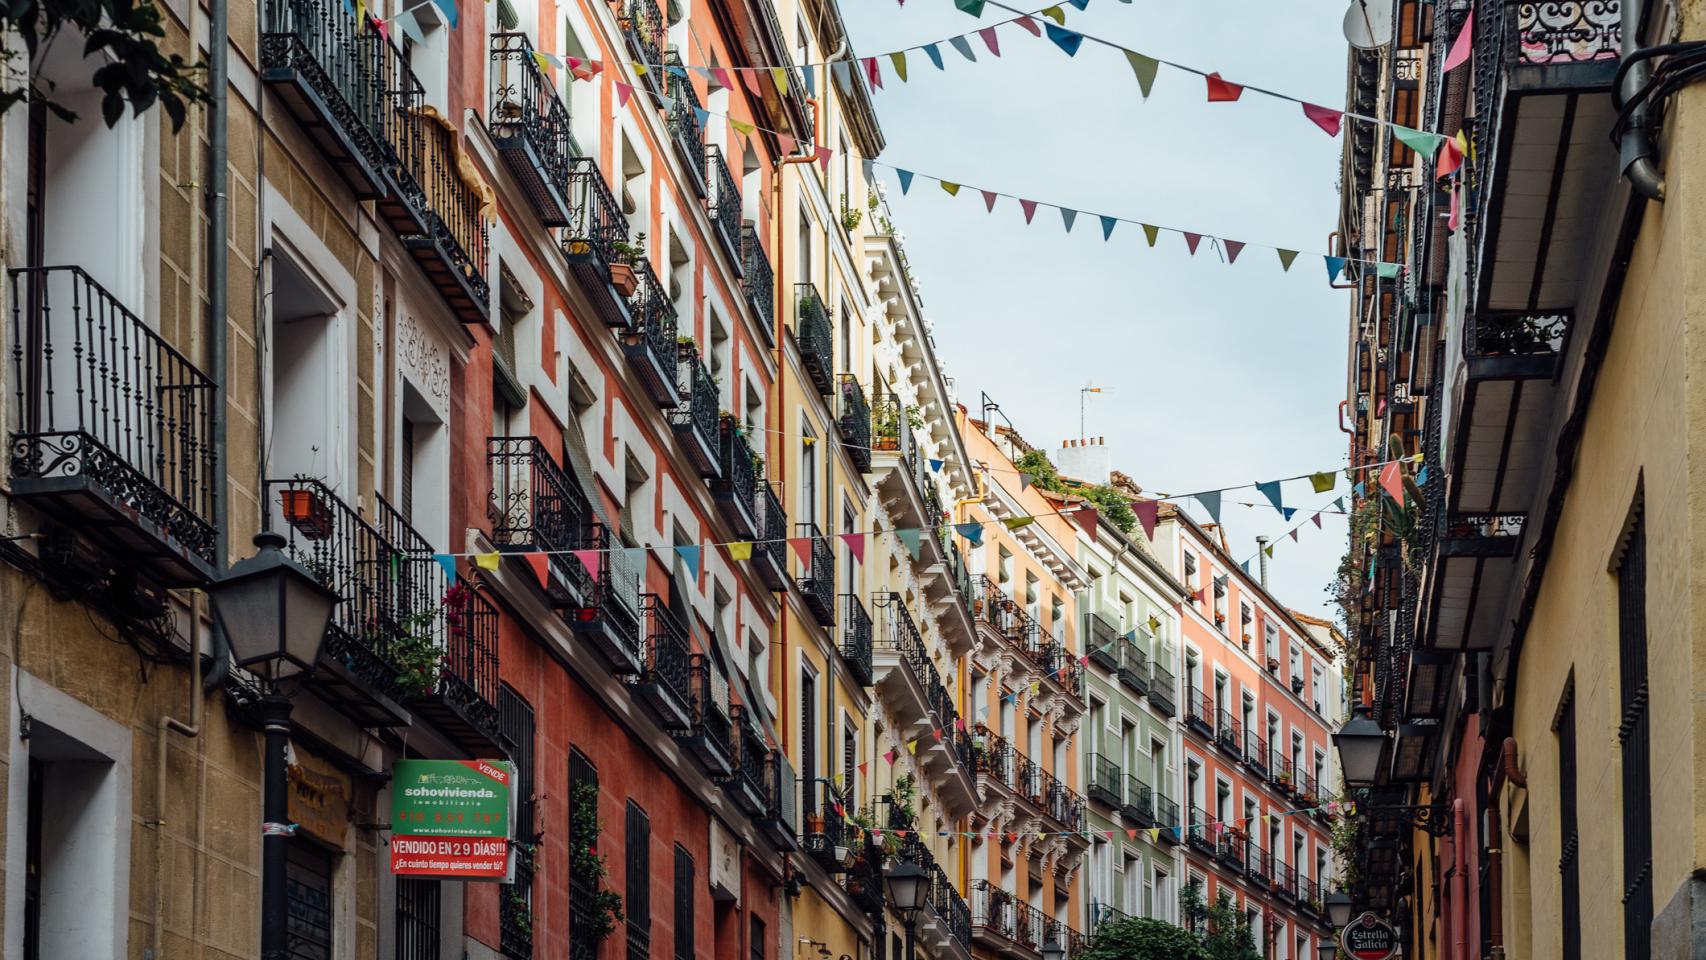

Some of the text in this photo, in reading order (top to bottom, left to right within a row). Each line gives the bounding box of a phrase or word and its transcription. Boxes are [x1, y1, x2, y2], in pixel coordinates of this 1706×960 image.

[479, 763, 505, 781] VENDE
[393, 840, 436, 854] VENDIDO
[438, 841, 451, 855] EN
[473, 839, 506, 856] DÍAS!!!
[395, 858, 503, 870] ¿En cuánto tiempo quieres vender tú?
[1352, 930, 1388, 939] Estrella
[1354, 939, 1388, 949] Galicia
